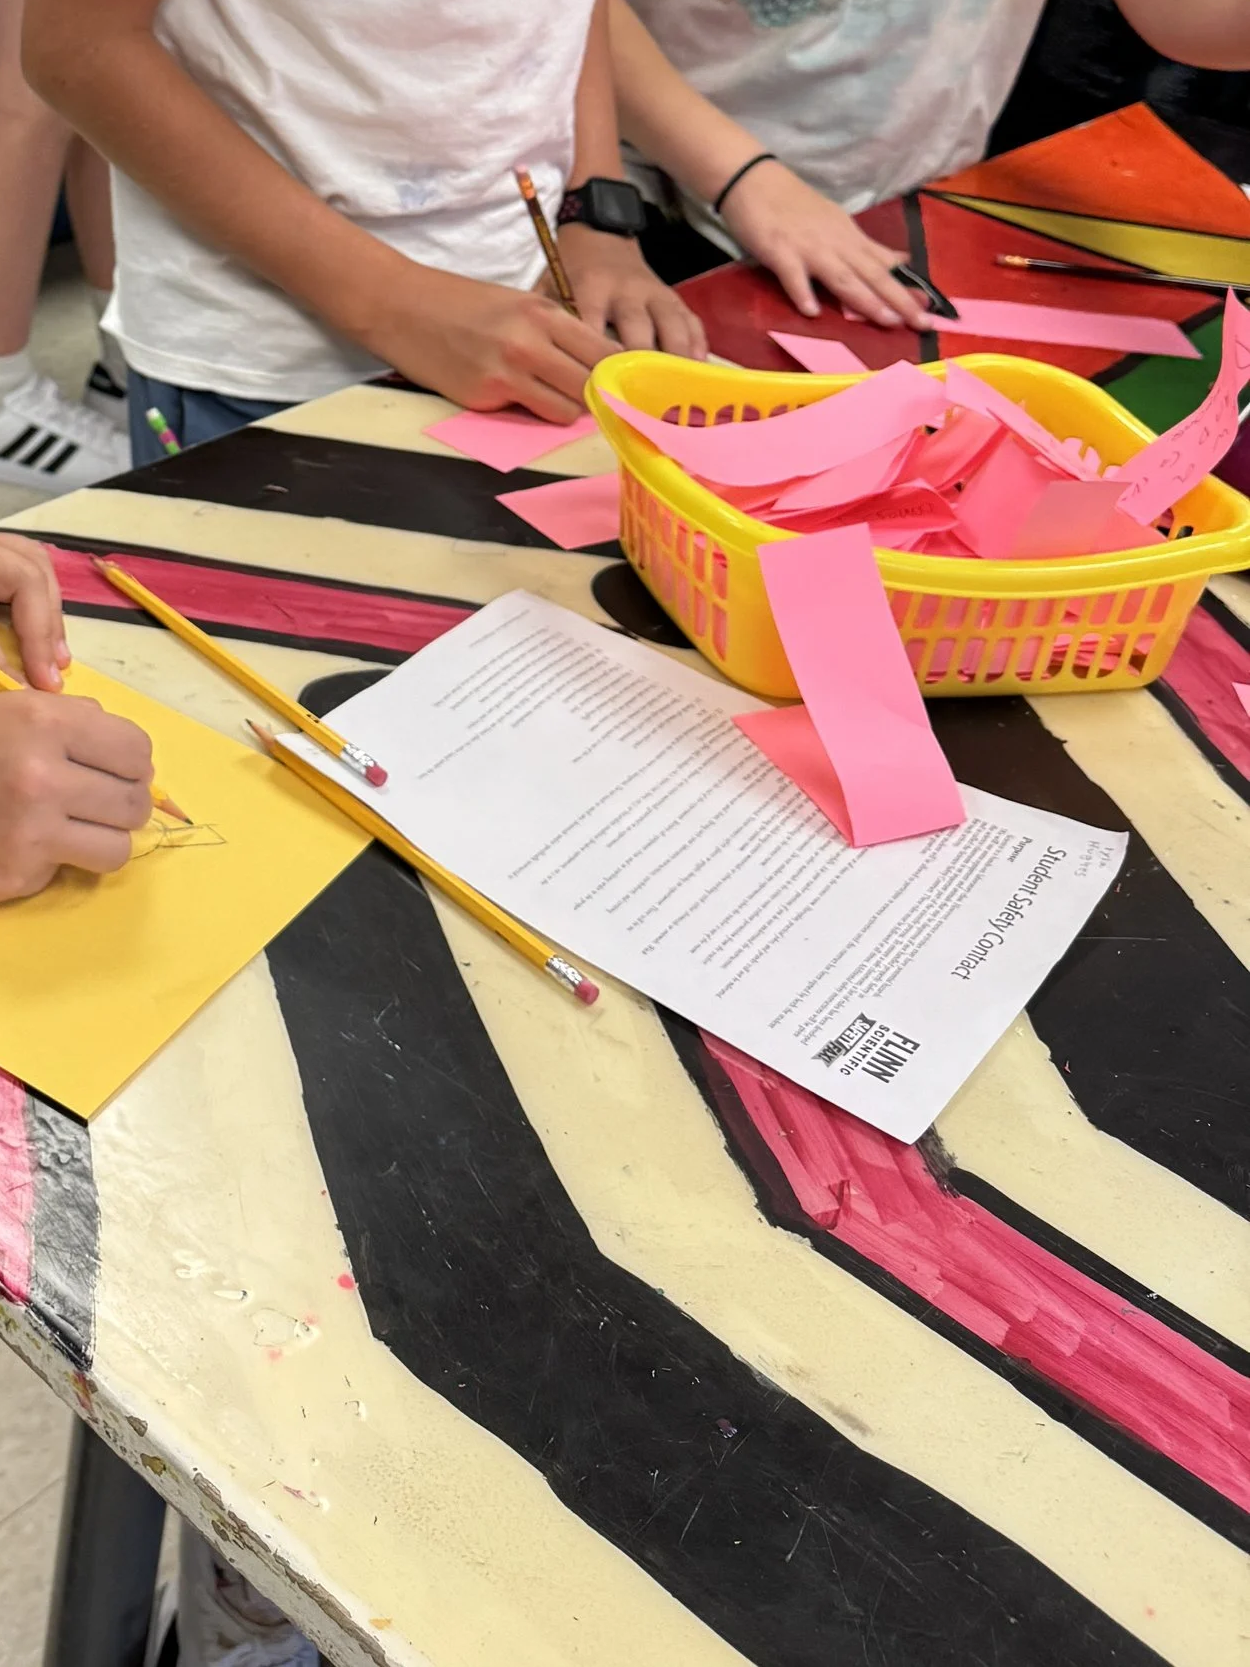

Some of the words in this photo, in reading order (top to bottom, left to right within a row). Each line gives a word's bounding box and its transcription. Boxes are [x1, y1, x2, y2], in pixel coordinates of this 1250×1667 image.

[1018, 846, 1068, 896] Student
[988, 894, 1034, 933] Safety
[950, 931, 1004, 980] Contract
[839, 1018, 871, 1052] SAFETY
[840, 1024, 890, 1075] SCIENTIFIC
[861, 1031, 921, 1084] FLINN
